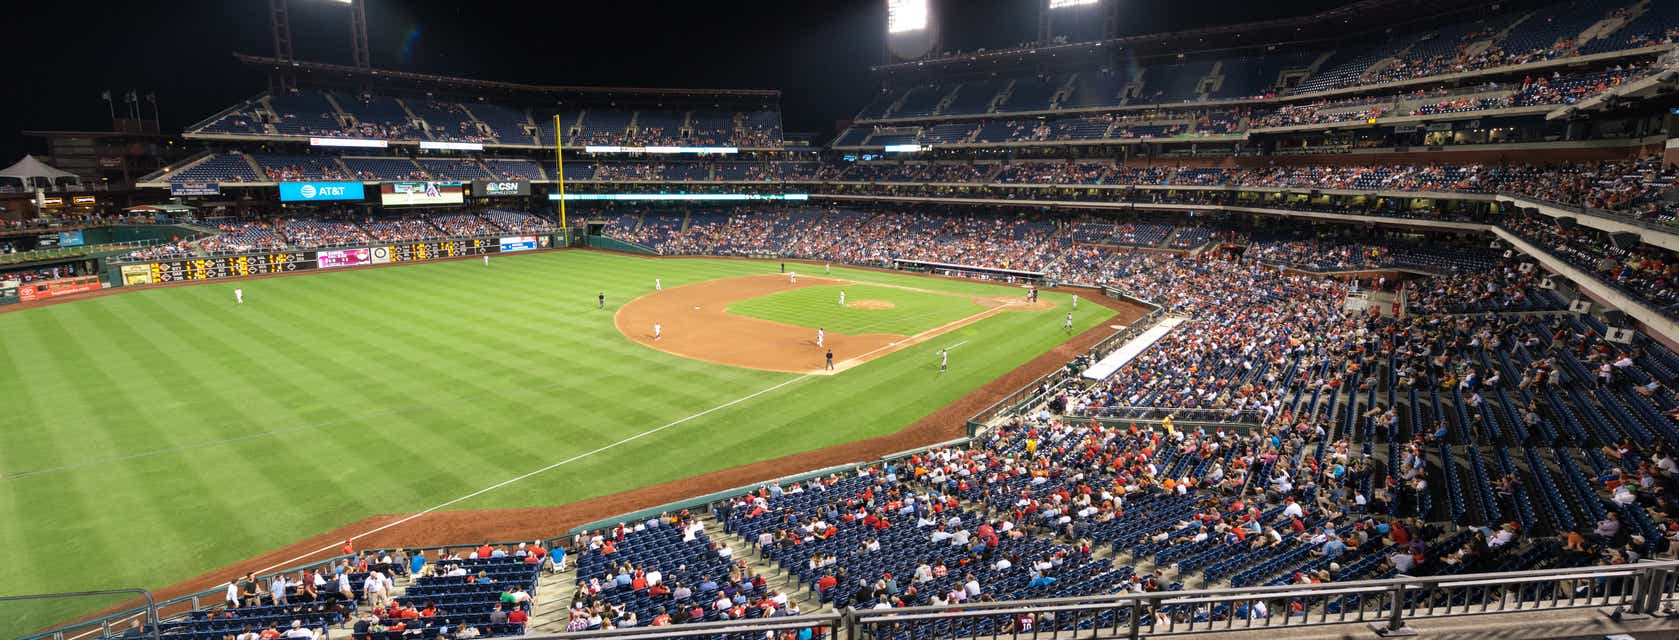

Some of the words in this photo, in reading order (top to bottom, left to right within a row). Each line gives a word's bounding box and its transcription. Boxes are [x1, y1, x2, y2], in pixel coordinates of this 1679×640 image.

[499, 182, 518, 190] CSN
[319, 187, 344, 195] AT&T
[1023, 622, 1031, 631] 10
